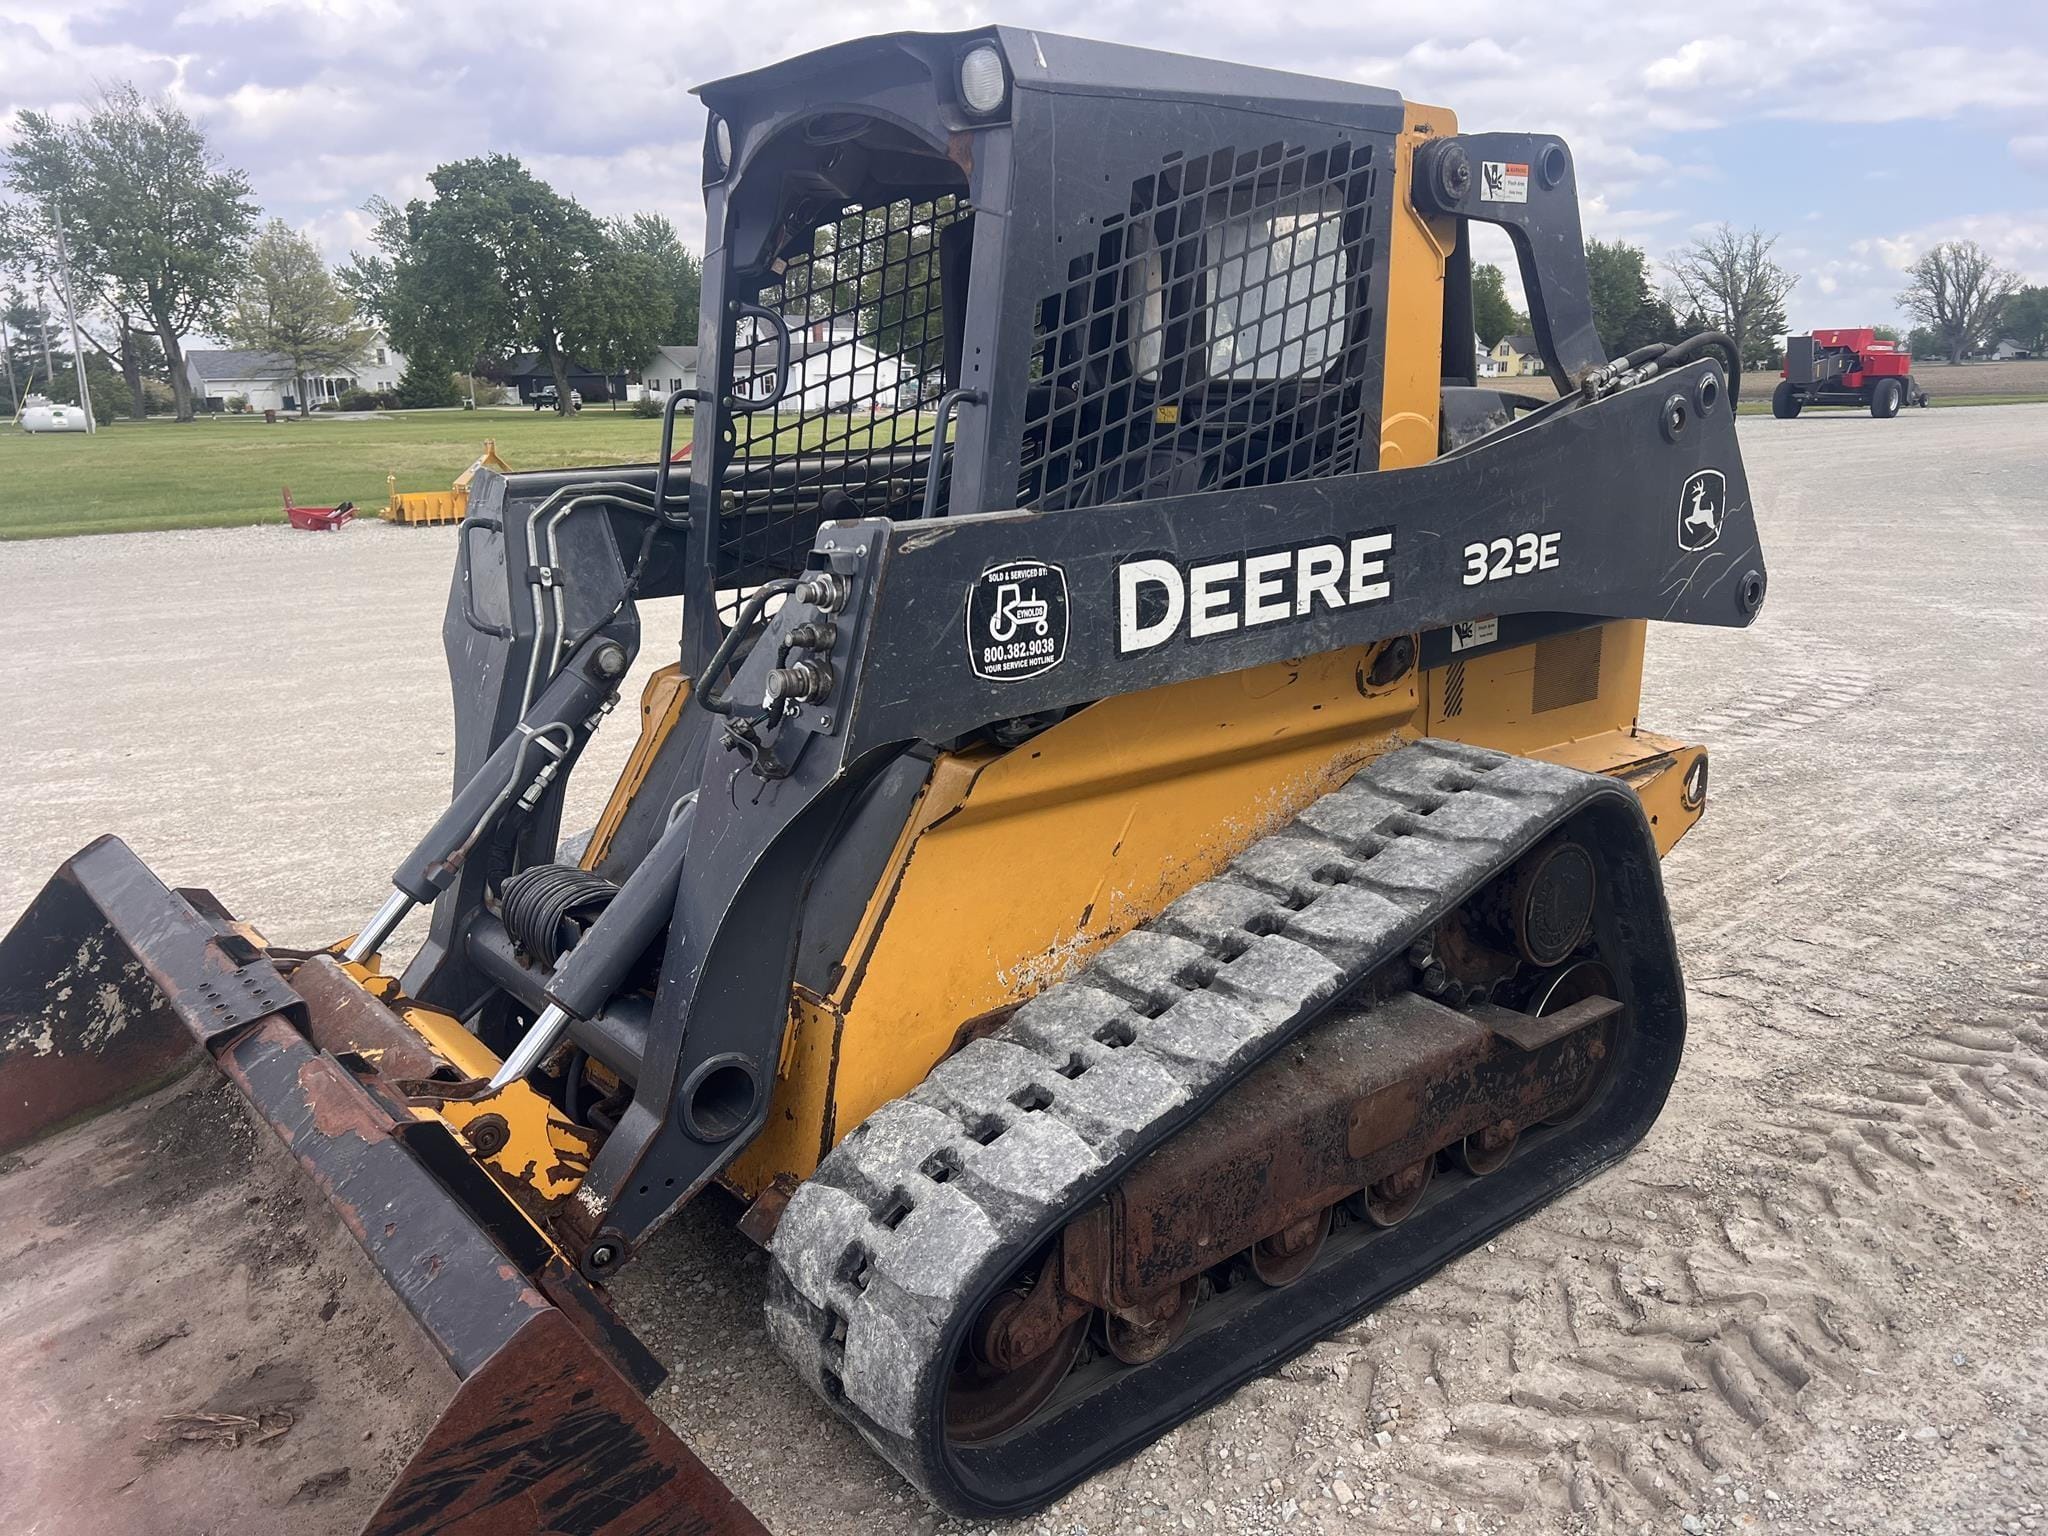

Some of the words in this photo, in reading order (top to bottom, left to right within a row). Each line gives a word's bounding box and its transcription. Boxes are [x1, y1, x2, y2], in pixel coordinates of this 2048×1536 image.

[1463, 532, 1561, 585] 323E
[988, 572, 1004, 583] SOLD
[1005, 572, 1010, 581] &
[1010, 569, 1038, 579] SERVICED
[1038, 567, 1048, 577] BY:
[1118, 532, 1393, 653] DEERE
[984, 638, 1054, 662] 800.382.9038
[984, 663, 1002, 673] YOUR
[1002, 659, 1028, 670] SERVICE
[1029, 655, 1054, 666] HOTLINE
